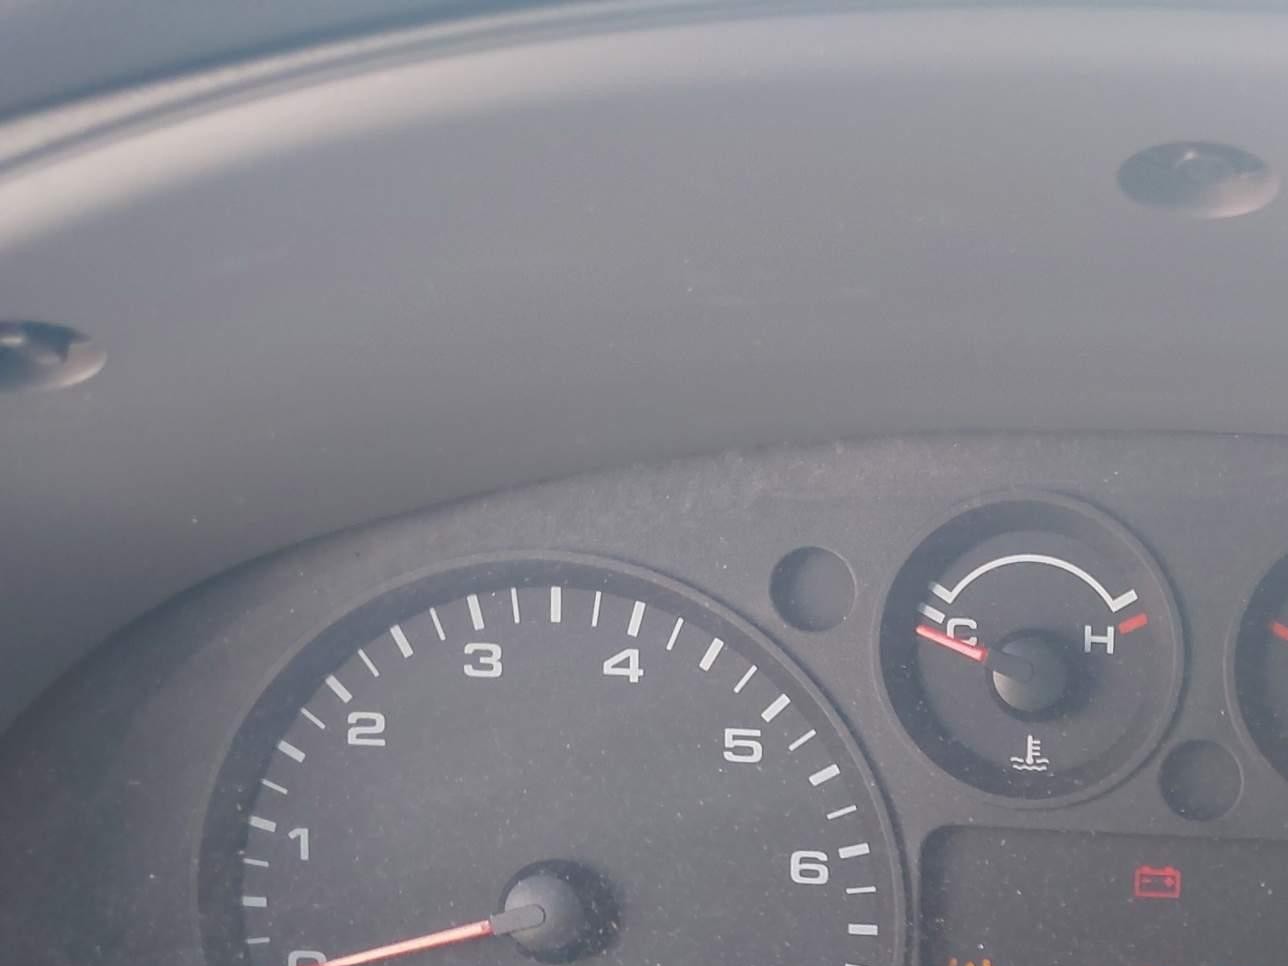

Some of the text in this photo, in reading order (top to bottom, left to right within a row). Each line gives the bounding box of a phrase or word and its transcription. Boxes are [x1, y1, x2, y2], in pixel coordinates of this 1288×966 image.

[946, 617, 978, 648] C
[1083, 625, 1115, 655] H
[463, 641, 502, 678] 3
[603, 647, 643, 682] 4
[347, 711, 386, 747] 2
[723, 728, 763, 763] 5
[287, 827, 310, 861] 1
[790, 849, 829, 885] 6
